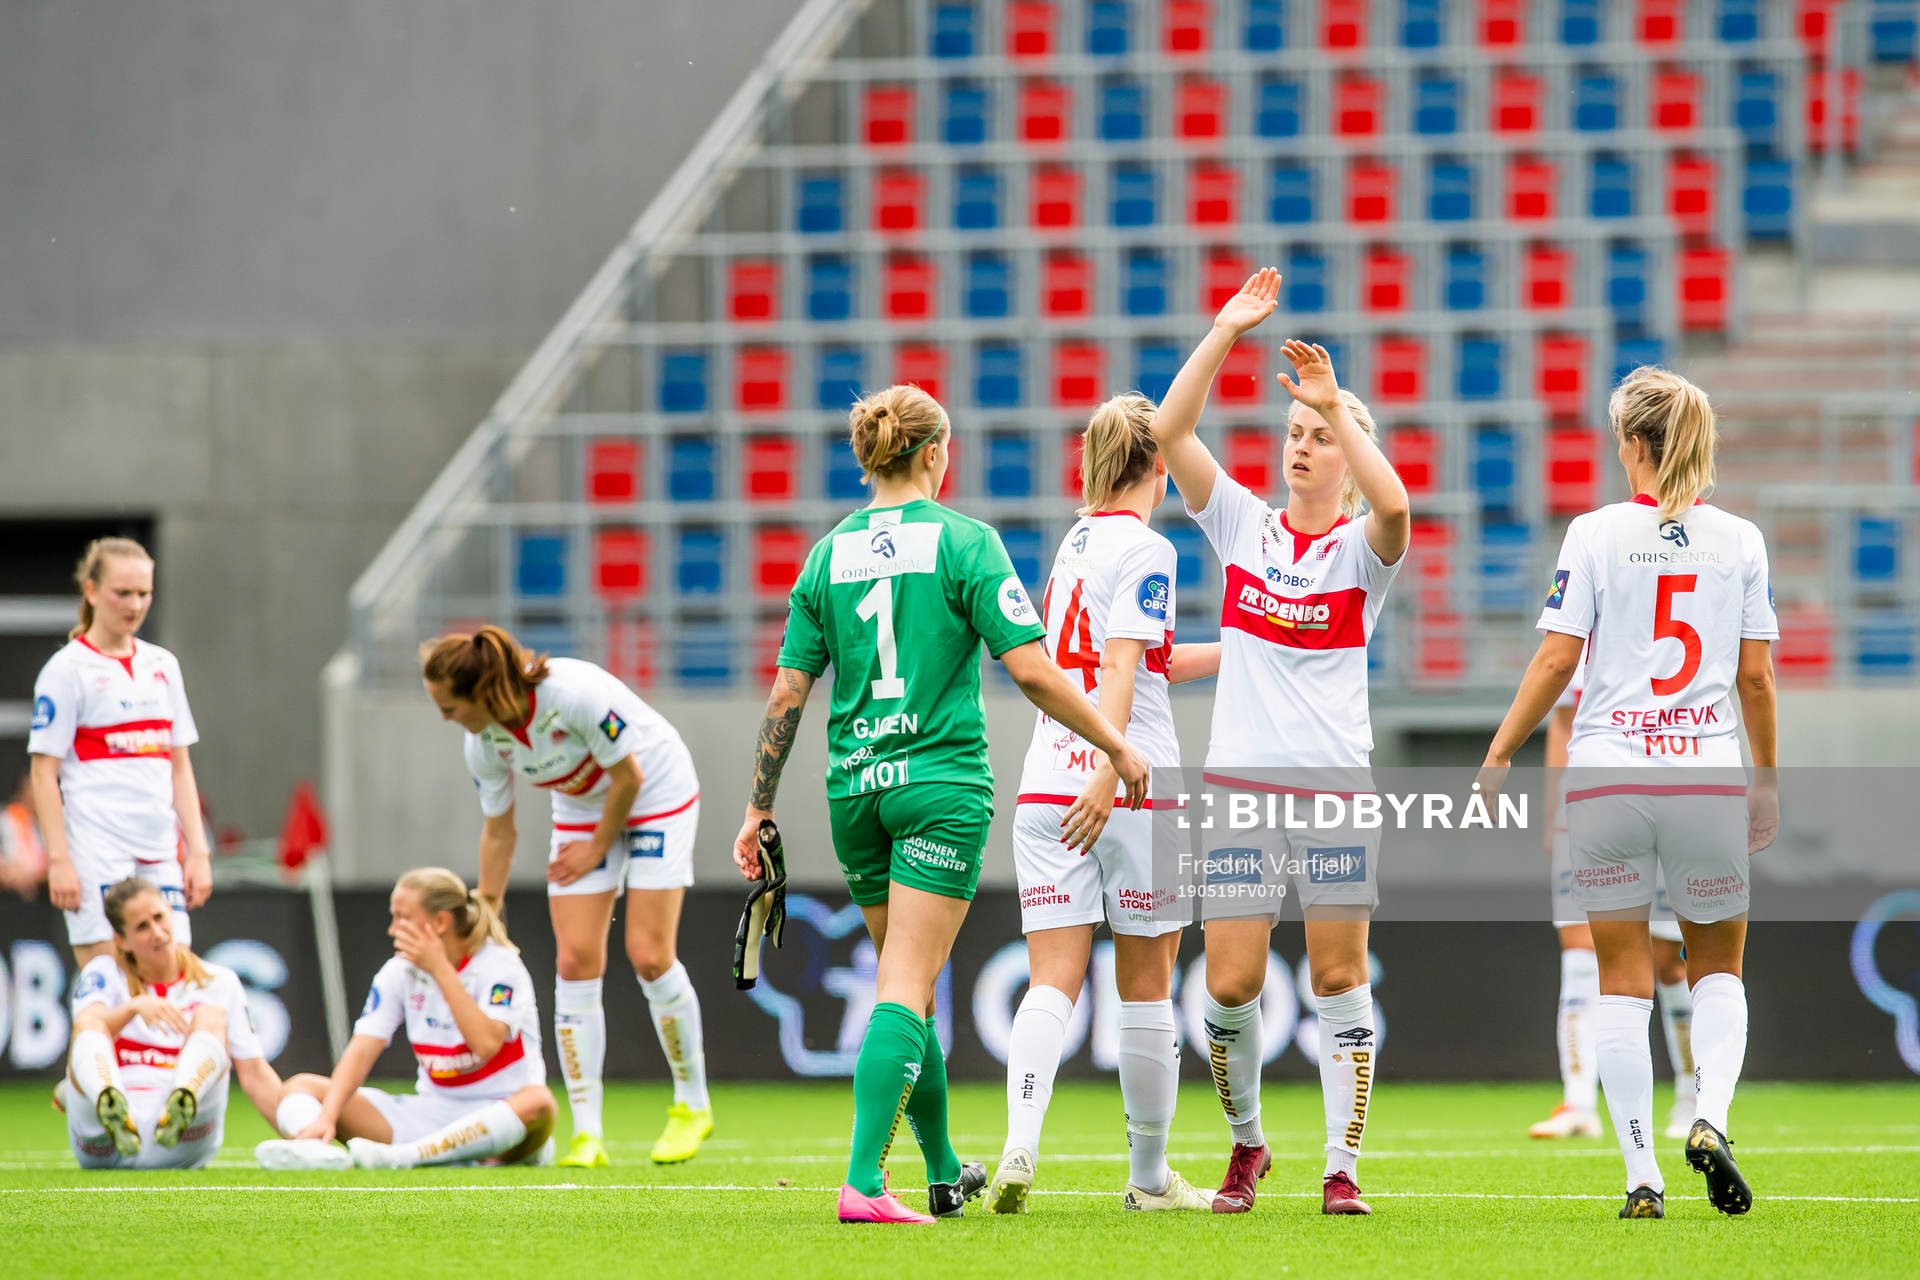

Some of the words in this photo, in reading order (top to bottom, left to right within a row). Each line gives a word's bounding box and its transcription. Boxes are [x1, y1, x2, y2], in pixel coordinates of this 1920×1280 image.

[1142, 598, 1168, 612] OBO
[1239, 583, 1330, 623] FRYDENBØ
[855, 577, 906, 700] 1
[1650, 574, 1703, 697] 5
[859, 760, 908, 793] MOT
[902, 843, 968, 873] STORSENTER
[1573, 863, 1626, 878] LAGUNEN
[1577, 872, 1641, 889] STORSENTER
[1686, 874, 1737, 889] LAGUNEN
[1020, 884, 1056, 899] GUNEN
[1118, 887, 1167, 901] LAGUNEN
[1685, 882, 1745, 899] STORSENTER
[1021, 894, 1071, 910] ORSENTER
[1119, 894, 1177, 912] STORSENTER
[1020, 1072, 1035, 1100] mbro
[1344, 1050, 1370, 1151] BUNNPRIS
[1629, 1118, 1645, 1150] umbro
